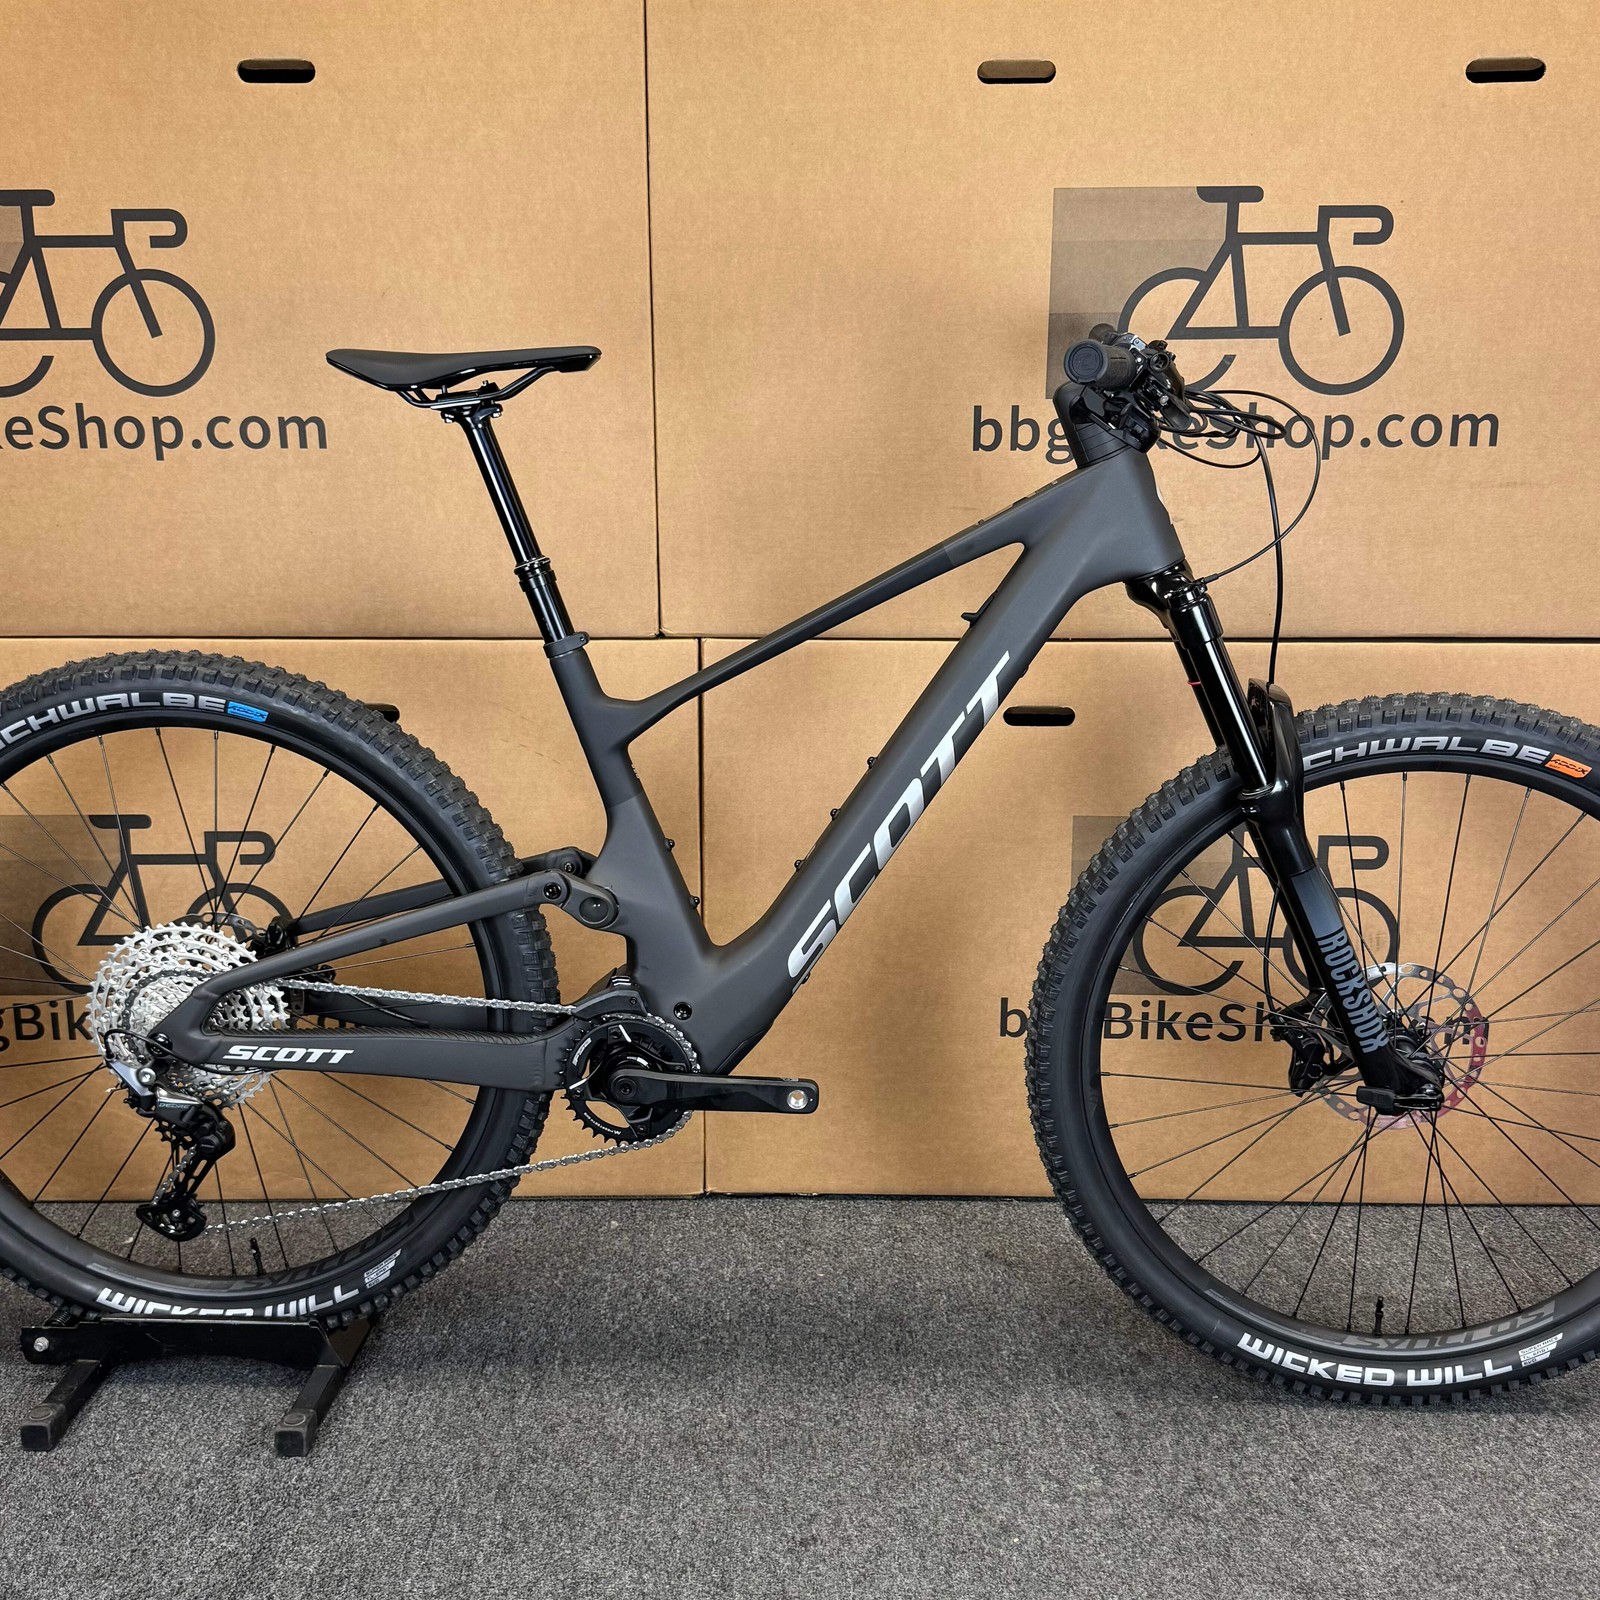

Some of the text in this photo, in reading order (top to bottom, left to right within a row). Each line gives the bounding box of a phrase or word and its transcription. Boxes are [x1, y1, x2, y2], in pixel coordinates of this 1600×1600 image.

[0, 402, 328, 461] eShop.com
[1302, 736, 1550, 771] CHWALBE
[787, 650, 1010, 994] SCOTT
[1317, 931, 1390, 1054] ROCKSHOX
[222, 1045, 354, 1064] SCOTT
[1236, 1332, 1513, 1386] WICKED WILL
